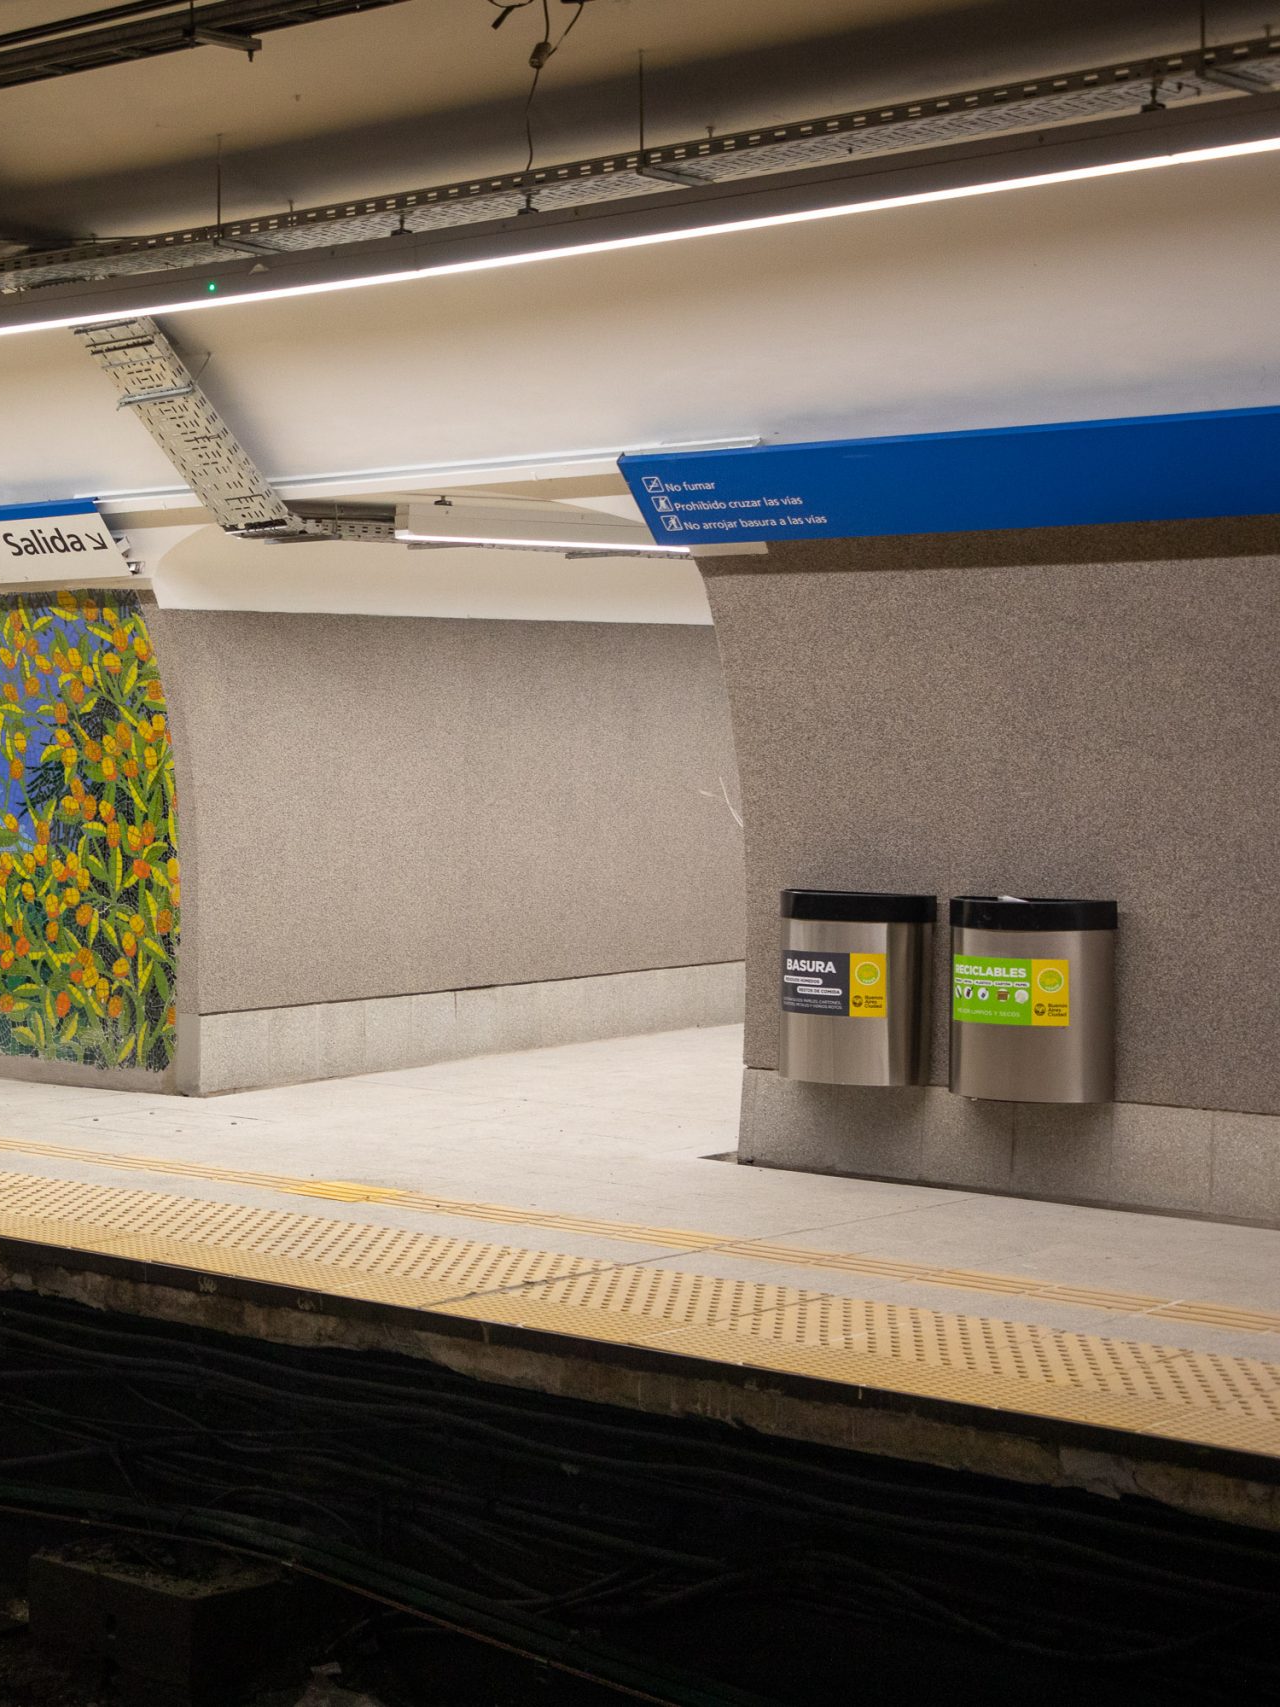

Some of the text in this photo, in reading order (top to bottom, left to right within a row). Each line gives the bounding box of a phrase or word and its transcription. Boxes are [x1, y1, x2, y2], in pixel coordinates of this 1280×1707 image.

[665, 480, 715, 492] No fumar
[674, 495, 803, 511] Prohibido cruzar las vías
[684, 514, 828, 531] No arrojar basura a las vías
[2, 527, 87, 557] Salida
[786, 958, 837, 974] BASURA
[955, 963, 1027, 978] RECICLABLES
